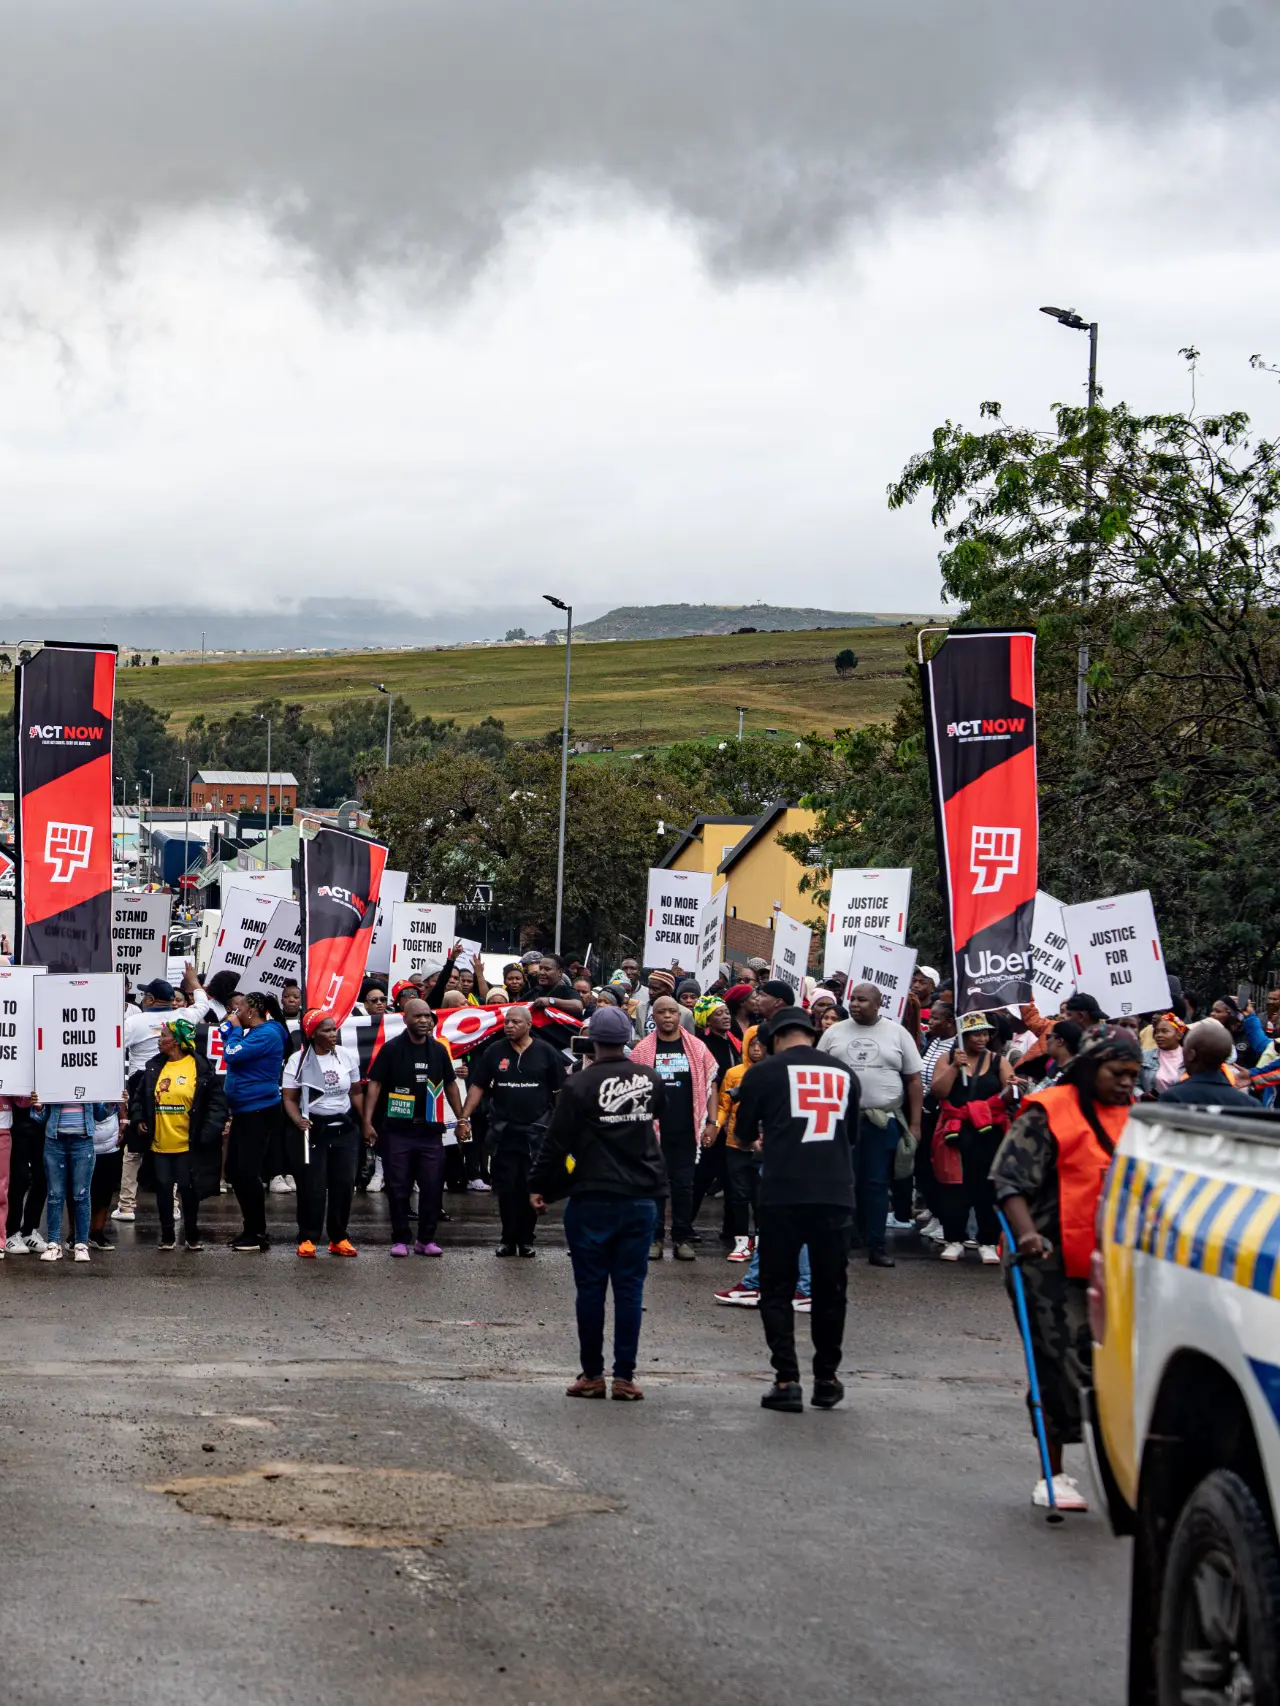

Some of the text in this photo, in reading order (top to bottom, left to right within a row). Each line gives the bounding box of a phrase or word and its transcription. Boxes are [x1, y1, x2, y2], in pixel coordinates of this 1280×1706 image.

[64, 726, 103, 740] NOW
[982, 718, 1025, 733] NOW
[661, 895, 698, 910] NO MORE
[848, 897, 888, 909] JUSTICE
[116, 910, 148, 922] STAND
[662, 913, 694, 927] SILENCE
[842, 916, 891, 928] FOR GBVF
[240, 918, 267, 934] HAND
[410, 921, 436, 934] STAND
[112, 928, 155, 940] OGETHER
[655, 930, 699, 946] SPEAK OUT
[1044, 932, 1067, 951] END
[1090, 926, 1136, 947] JUSTICE
[117, 946, 142, 958] STOP
[274, 938, 302, 956] DEMA
[403, 939, 442, 953] TOGETHER
[273, 957, 297, 972] SAFE
[411, 958, 426, 970] STO
[784, 948, 796, 966] ZERO
[964, 950, 1032, 978] Uber
[1106, 949, 1128, 965] FOR
[116, 963, 142, 975] GBVF
[1053, 958, 1066, 972] IN
[259, 971, 288, 988] SPAC
[774, 965, 800, 991] TOLERANCE
[861, 966, 898, 990] NO MORE
[1110, 970, 1132, 986] ALU
[3, 1000, 17, 1015] TO
[62, 1007, 96, 1022] NO TO
[63, 1030, 96, 1045] CHILD
[61, 1052, 98, 1068] ABUSE
[598, 1074, 653, 1108] Faster
[390, 1106, 410, 1115] AFRICA
[392, 1100, 411, 1108] SOUTH
[600, 1113, 653, 1123] BROOKLYN TEAM
